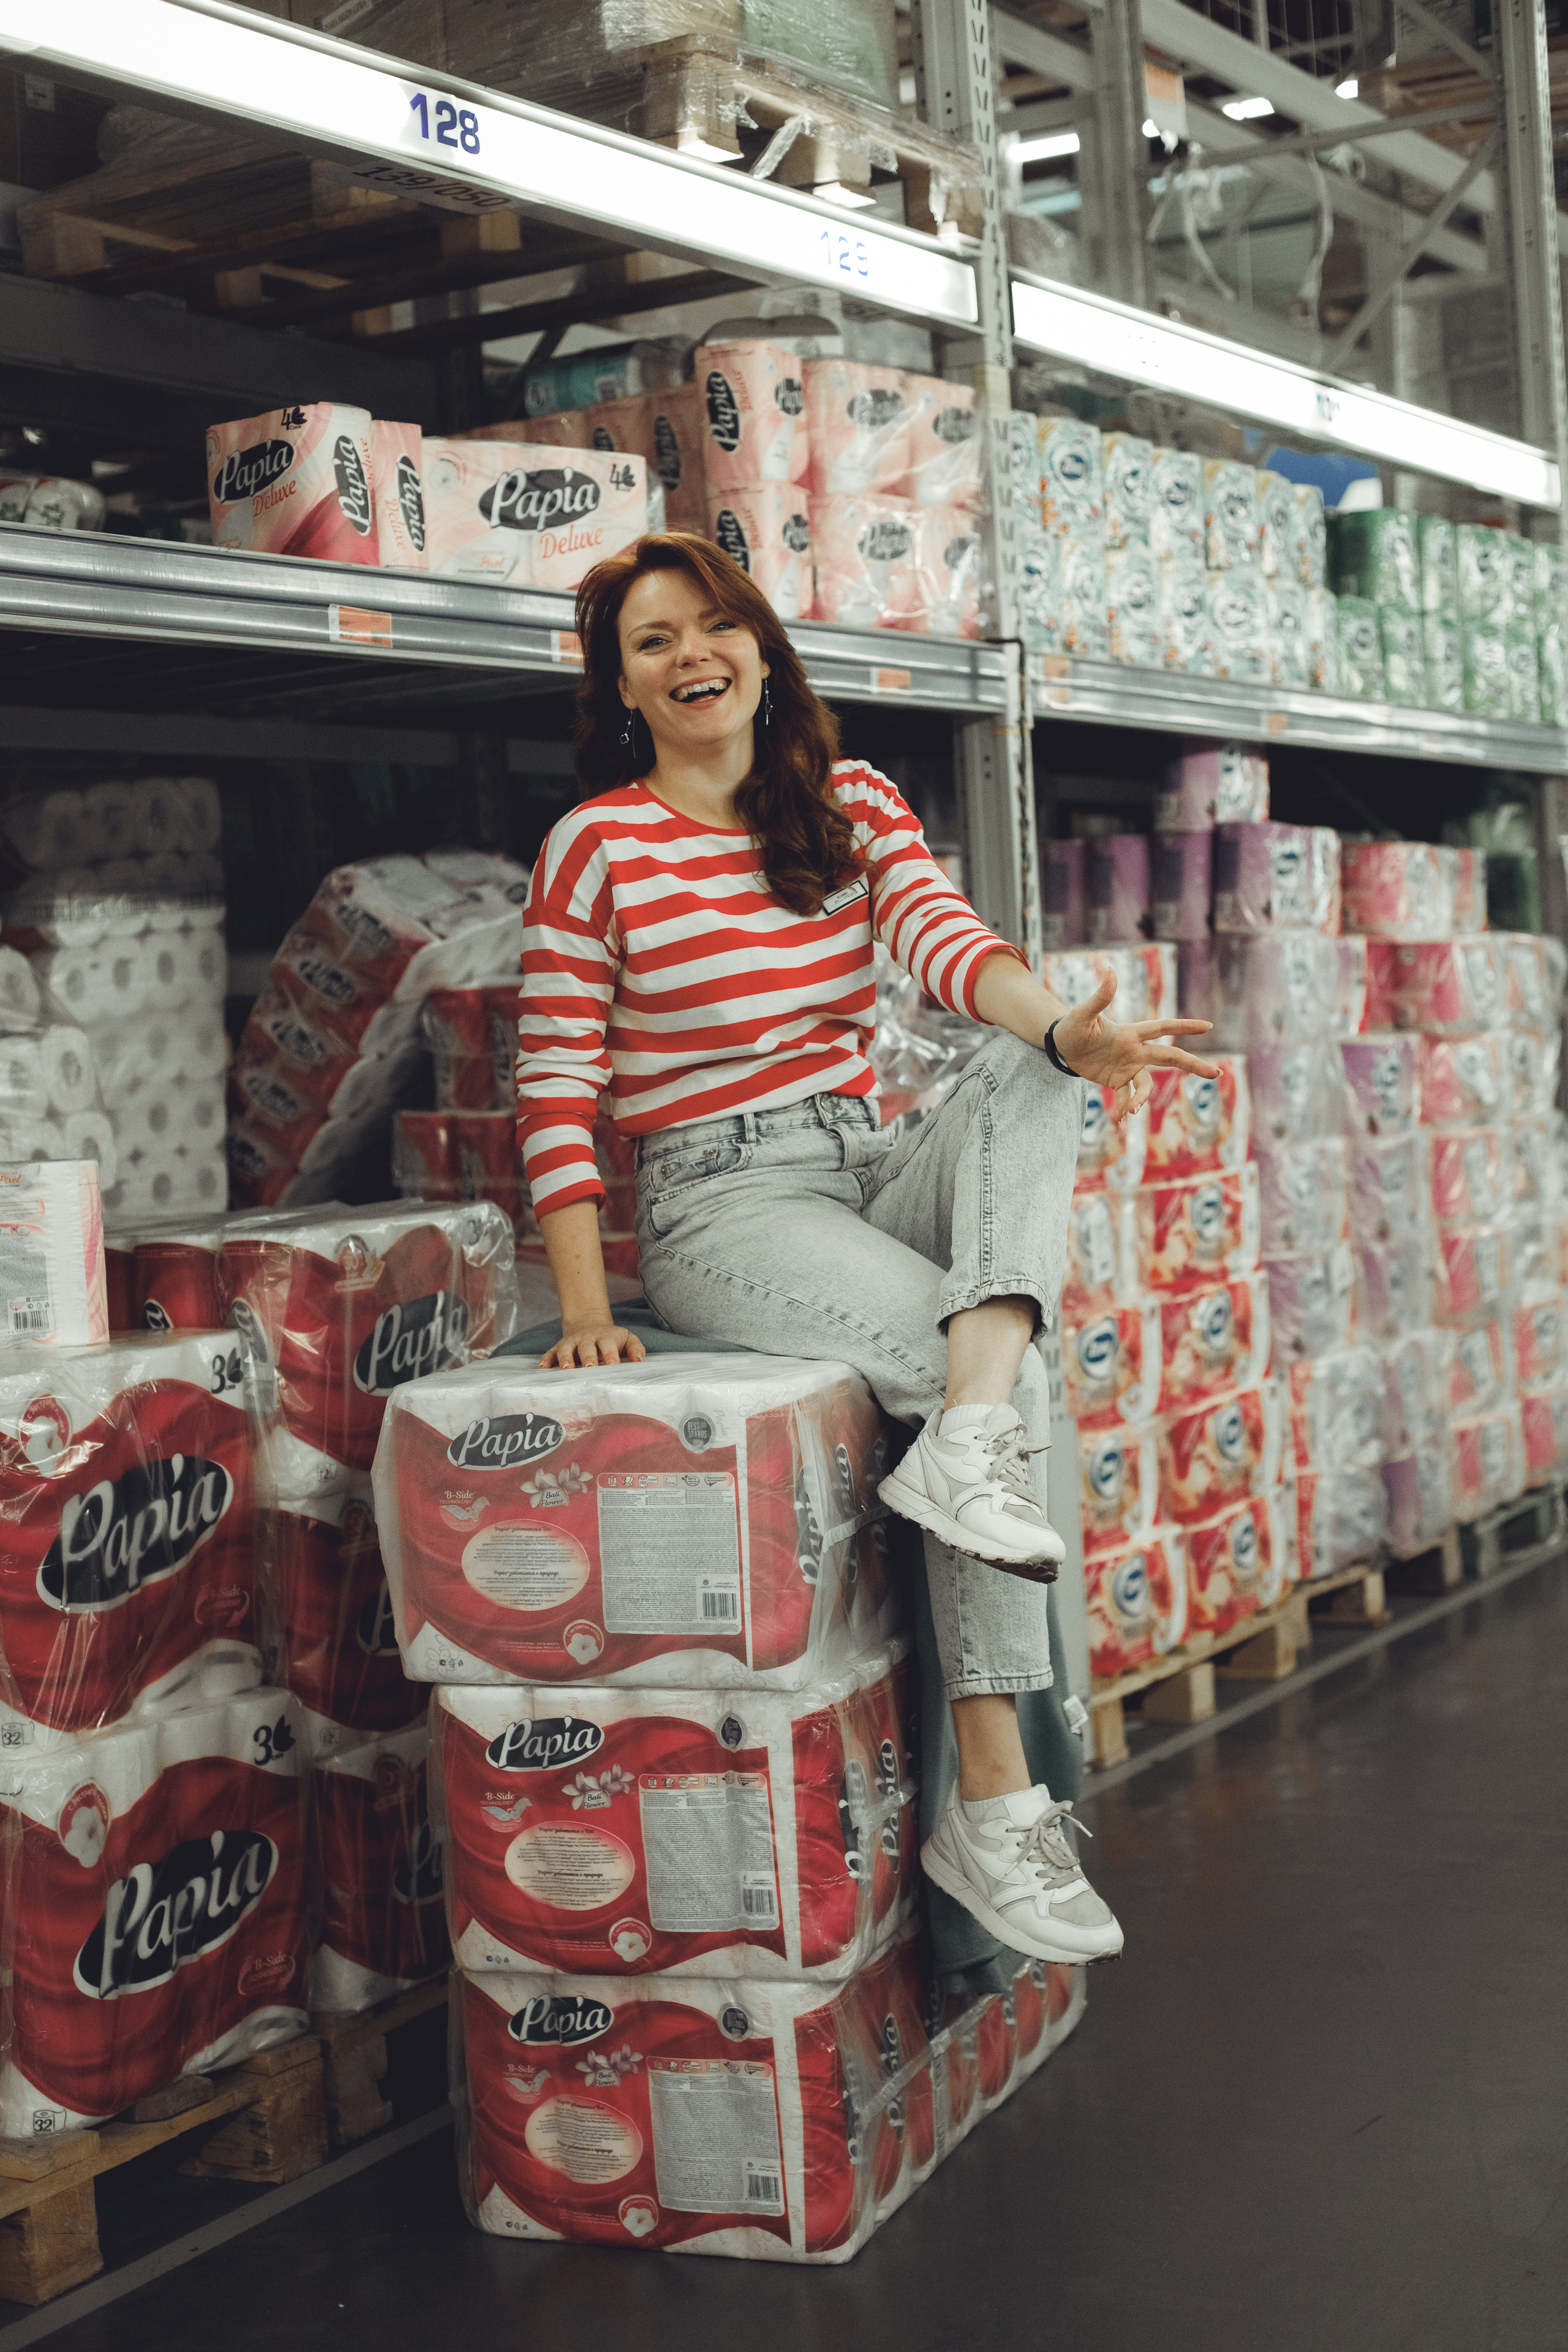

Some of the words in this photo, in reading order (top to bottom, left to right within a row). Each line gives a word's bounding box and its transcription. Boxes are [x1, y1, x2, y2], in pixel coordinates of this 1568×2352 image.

[410, 93, 480, 154] 128
[821, 232, 868, 276] 129
[282, 408, 292, 430] 4
[221, 439, 291, 503] Papia
[333, 439, 371, 527] Papia
[609, 463, 624, 489] 4
[252, 480, 297, 517] Deluxe
[397, 461, 424, 548] Papia
[491, 467, 597, 531] Papia
[539, 526, 603, 559] Deluxe
[368, 1291, 464, 1392] Papia
[211, 1354, 226, 1394] 3
[458, 1413, 560, 1466] Papia
[687, 1422, 699, 1430] BEST
[445, 1490, 474, 1499] B-Side
[541, 1498, 564, 1507] Flower
[59, 1453, 219, 1610] Papia
[3, 1732, 21, 1745] 32
[254, 1725, 272, 1766] 3
[498, 1716, 598, 1769] Papia
[582, 1801, 606, 1809] Flower
[99, 1830, 263, 1998] Papia
[519, 1993, 609, 2043] Papia
[507, 2064, 538, 2073] B-Side
[35, 2119, 53, 2132] 32
